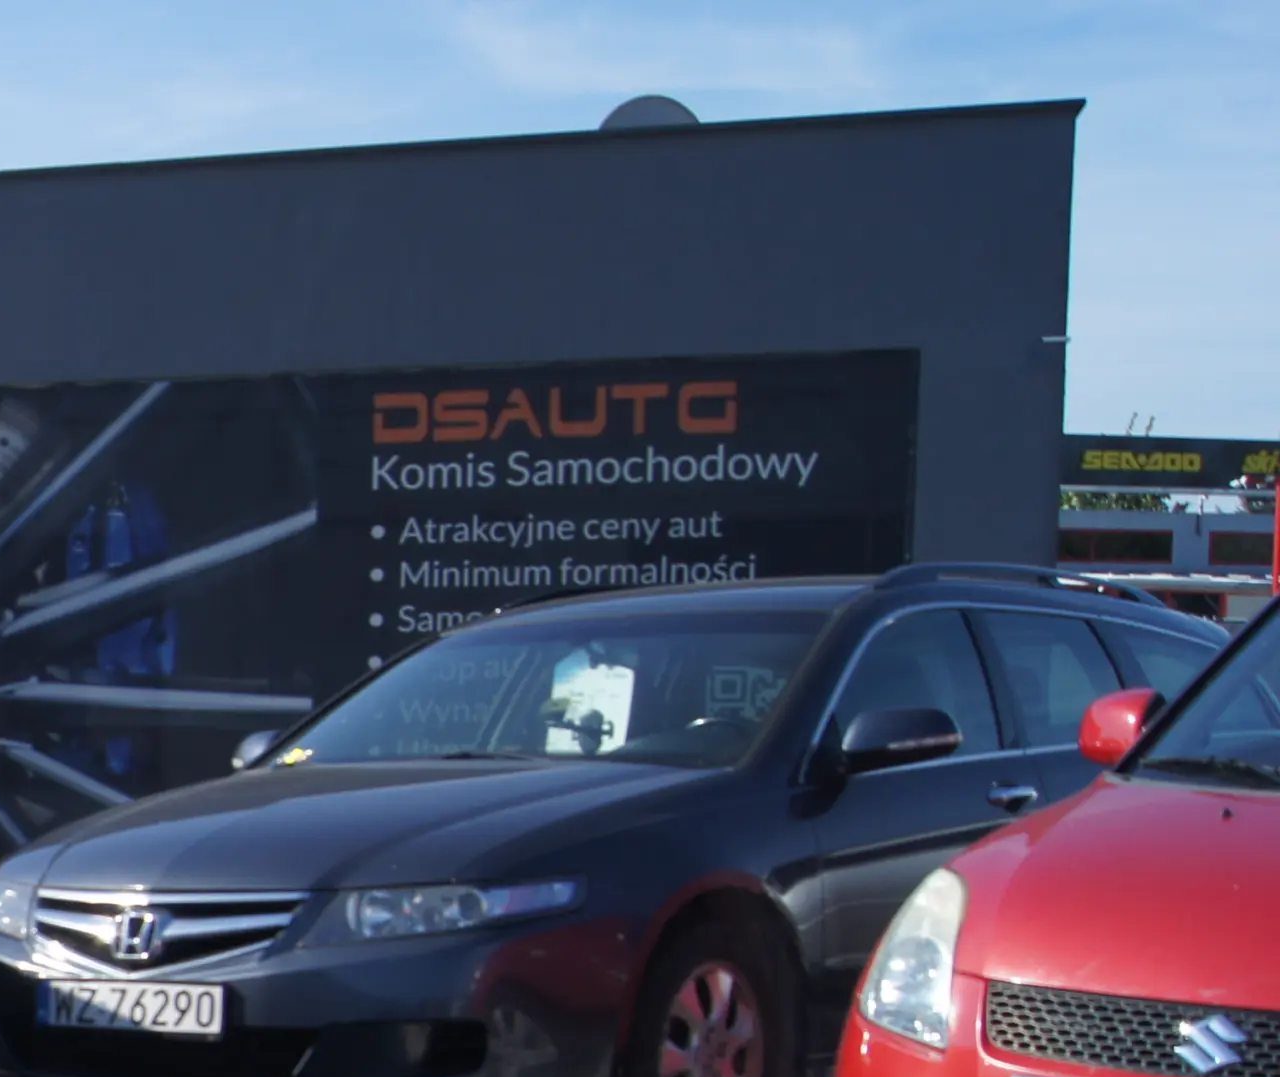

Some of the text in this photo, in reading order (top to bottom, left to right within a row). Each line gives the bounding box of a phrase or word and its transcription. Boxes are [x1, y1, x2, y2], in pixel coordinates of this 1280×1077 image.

[370, 443, 819, 490] Komis Samochodowy
[398, 511, 723, 547] Atrakcyjne ceny aut
[399, 553, 757, 589] Minimum formalności
[109, 987, 215, 1027] 76290
